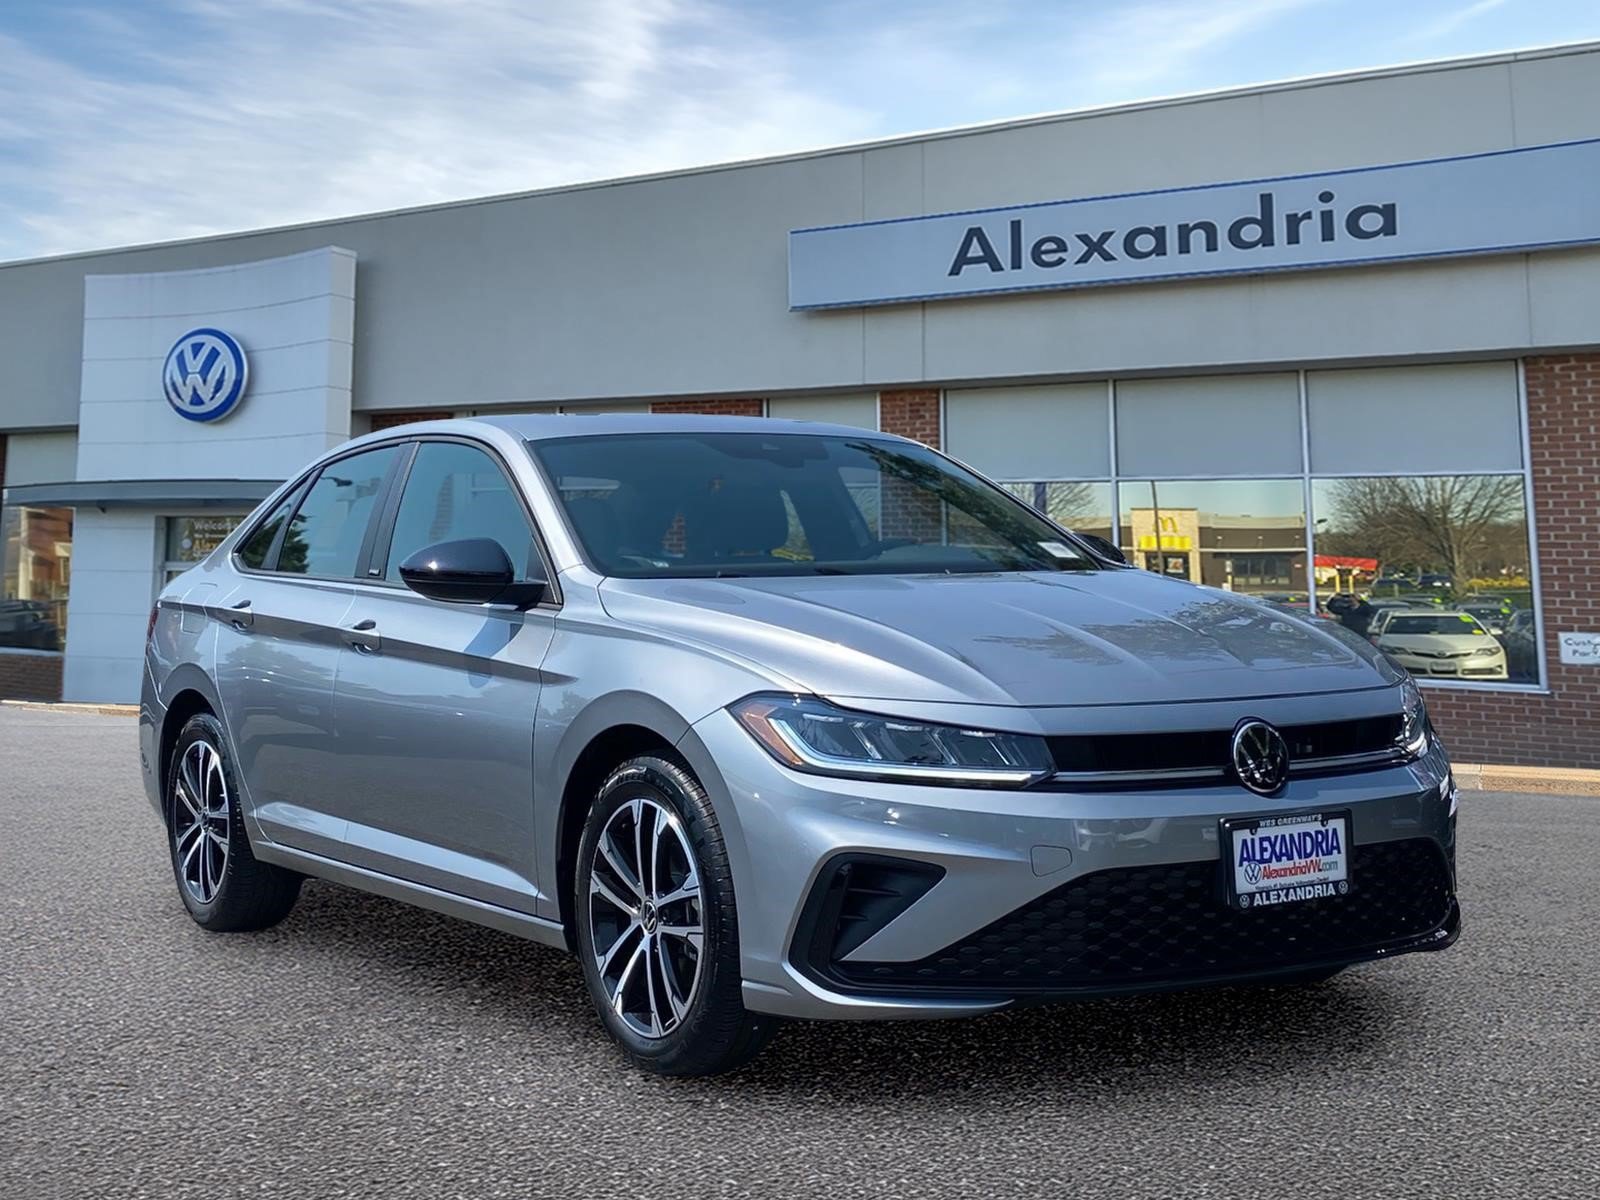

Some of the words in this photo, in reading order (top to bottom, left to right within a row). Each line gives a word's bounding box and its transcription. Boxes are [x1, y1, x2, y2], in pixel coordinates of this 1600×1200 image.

[948, 191, 1398, 276] Alexandria
[166, 332, 240, 416] VW
[1239, 828, 1341, 867] ALEXANDRIA
[1253, 883, 1336, 906] ALEXANDRIA
